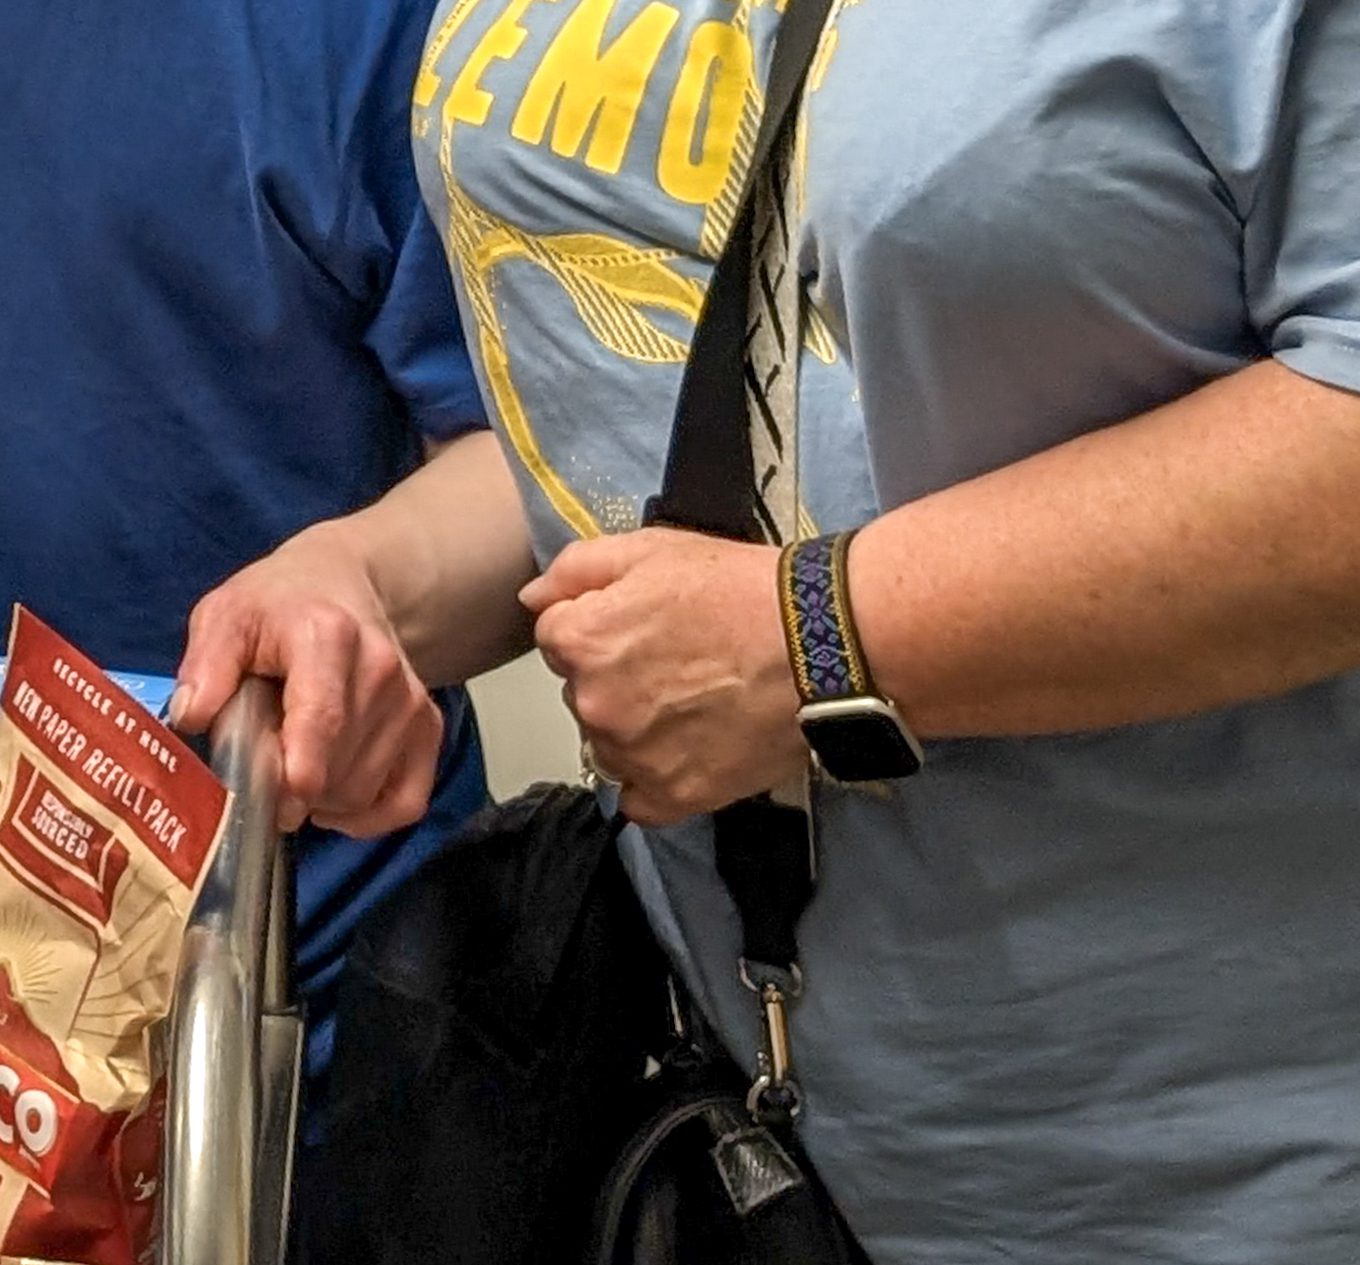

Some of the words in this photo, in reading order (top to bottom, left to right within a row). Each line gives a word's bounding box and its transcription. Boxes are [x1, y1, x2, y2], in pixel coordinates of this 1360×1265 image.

[12, 680, 43, 723] NEW
[37, 704, 87, 761] PAPER
[81, 748, 146, 816] REFILL
[142, 799, 187, 853] PACK
[53, 658, 114, 716] RECYCLE
[115, 711, 137, 734] AT
[138, 730, 178, 774] HOME
[31, 806, 89, 862] SOURCED
